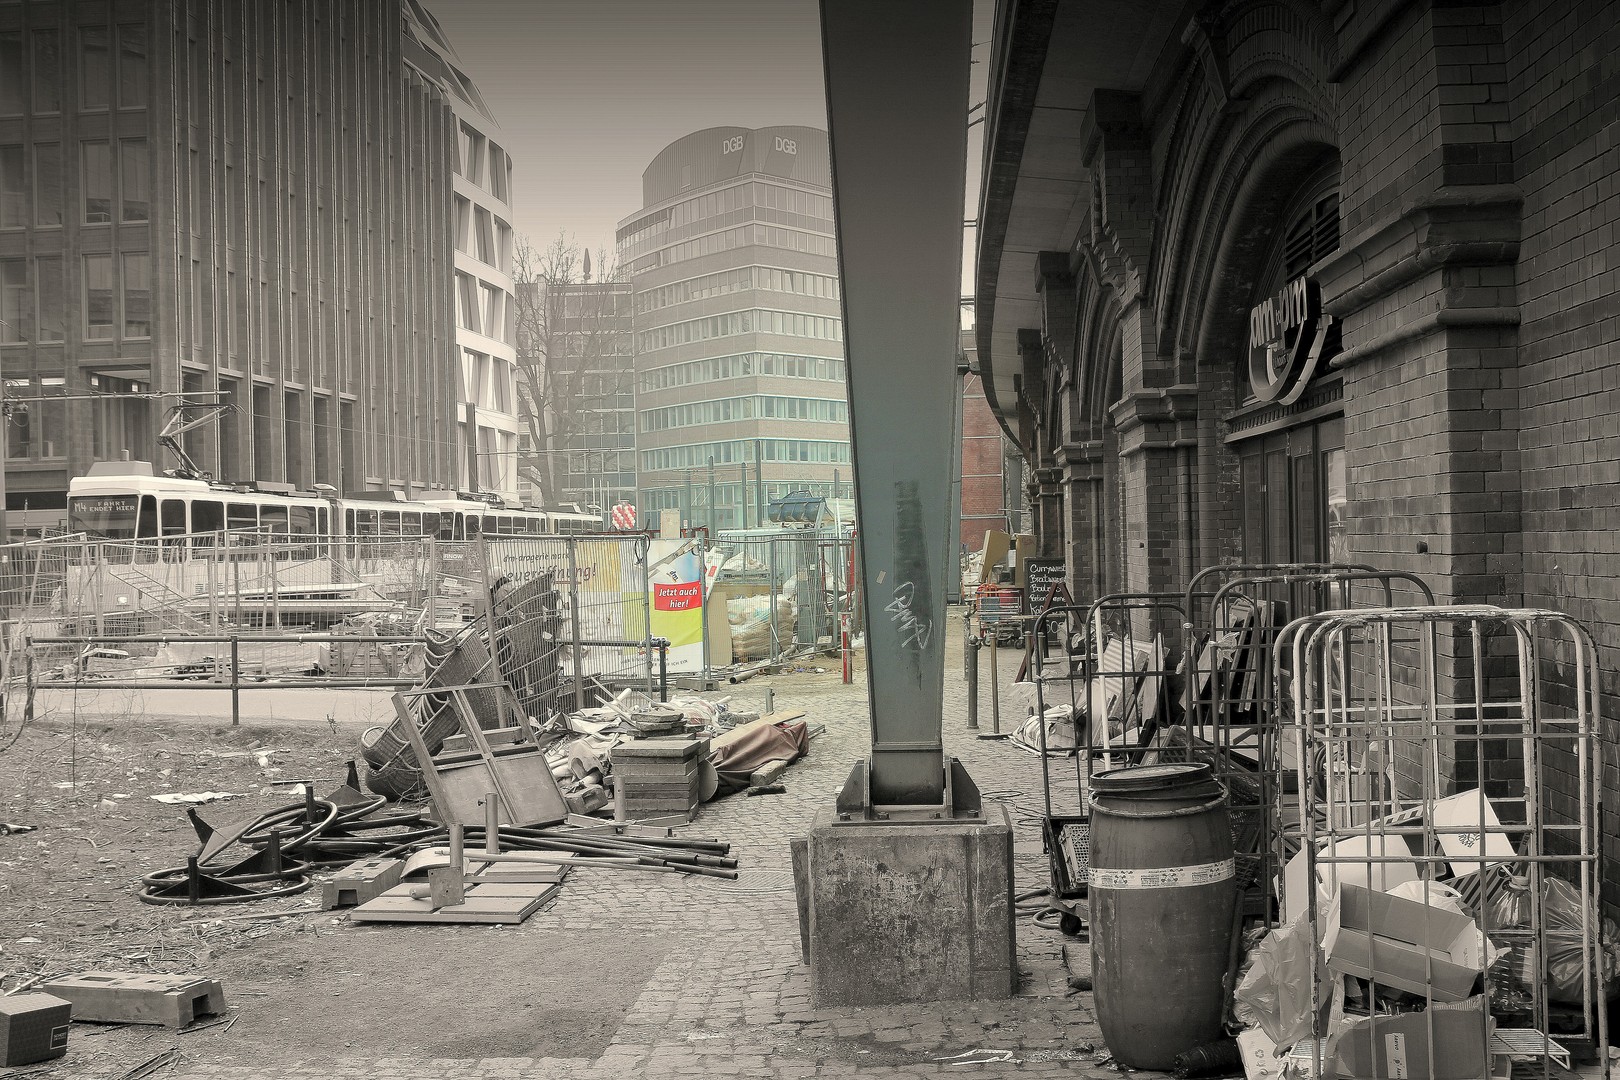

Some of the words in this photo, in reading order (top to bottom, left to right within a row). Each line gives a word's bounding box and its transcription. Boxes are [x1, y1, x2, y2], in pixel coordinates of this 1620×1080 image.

[723, 136, 744, 155] DGB
[775, 136, 797, 155] DGB
[1251, 297, 1276, 348] am
[1279, 276, 1308, 350] pm
[74, 502, 87, 513] M4
[658, 588, 678, 597] Jetzt
[679, 587, 698, 596] auch
[669, 599, 689, 608] hier!
